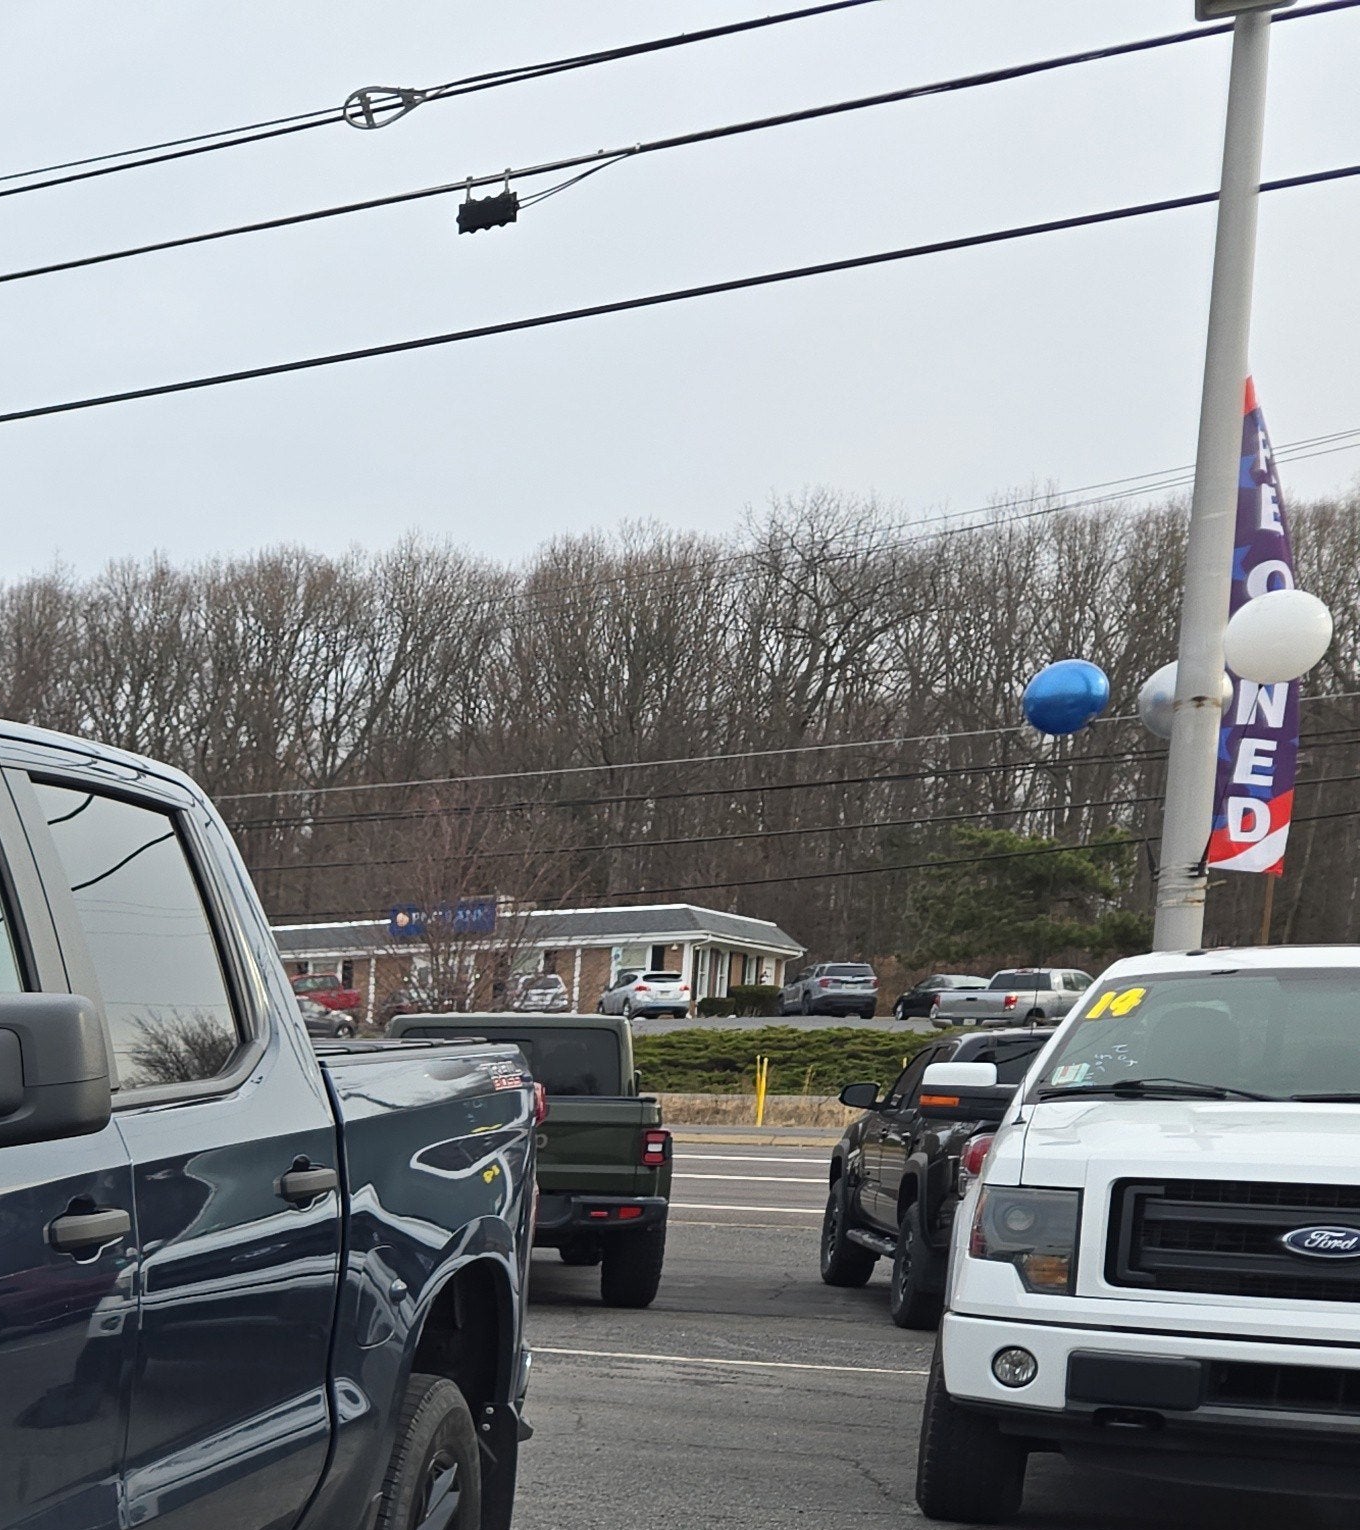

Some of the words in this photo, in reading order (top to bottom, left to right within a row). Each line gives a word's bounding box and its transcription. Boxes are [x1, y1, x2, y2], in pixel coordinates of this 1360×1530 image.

[1228, 558, 1294, 842] ONED
[1084, 987, 1146, 1019] 14
[1304, 1230, 1359, 1250] Ford
